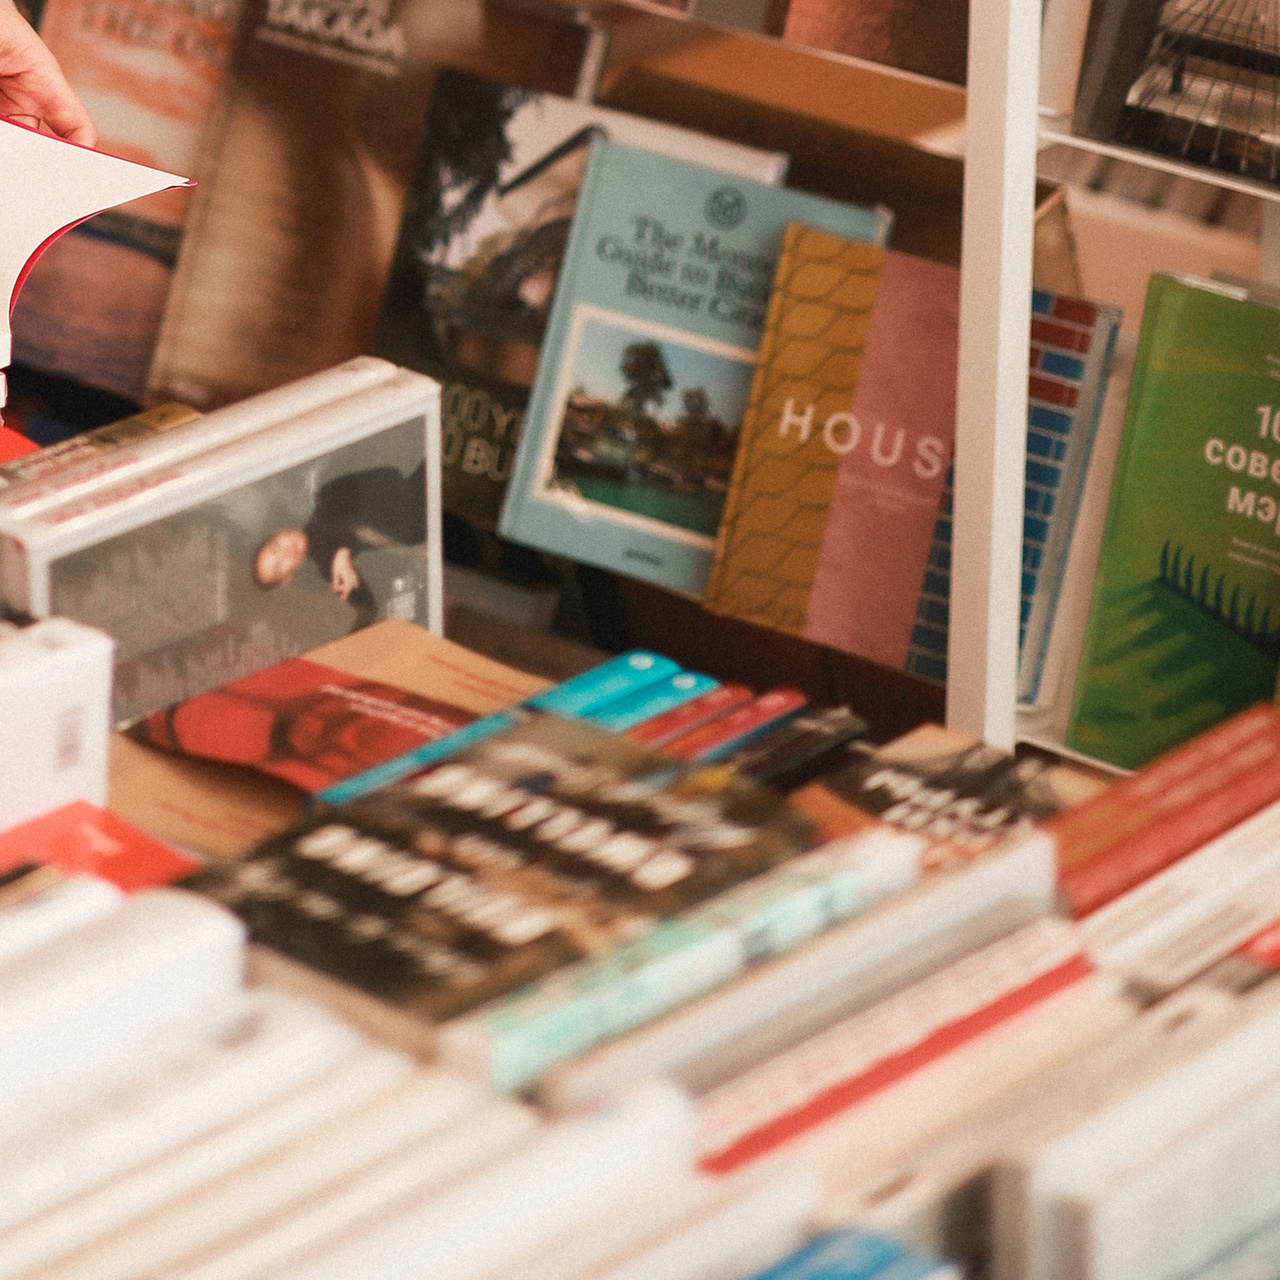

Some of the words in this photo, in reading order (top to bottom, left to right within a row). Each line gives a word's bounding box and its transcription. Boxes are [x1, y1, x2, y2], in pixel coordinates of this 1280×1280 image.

[631, 213, 683, 253] The
[596, 234, 675, 275] Guide
[625, 267, 704, 306] Better
[778, 397, 946, 480] HOUS
